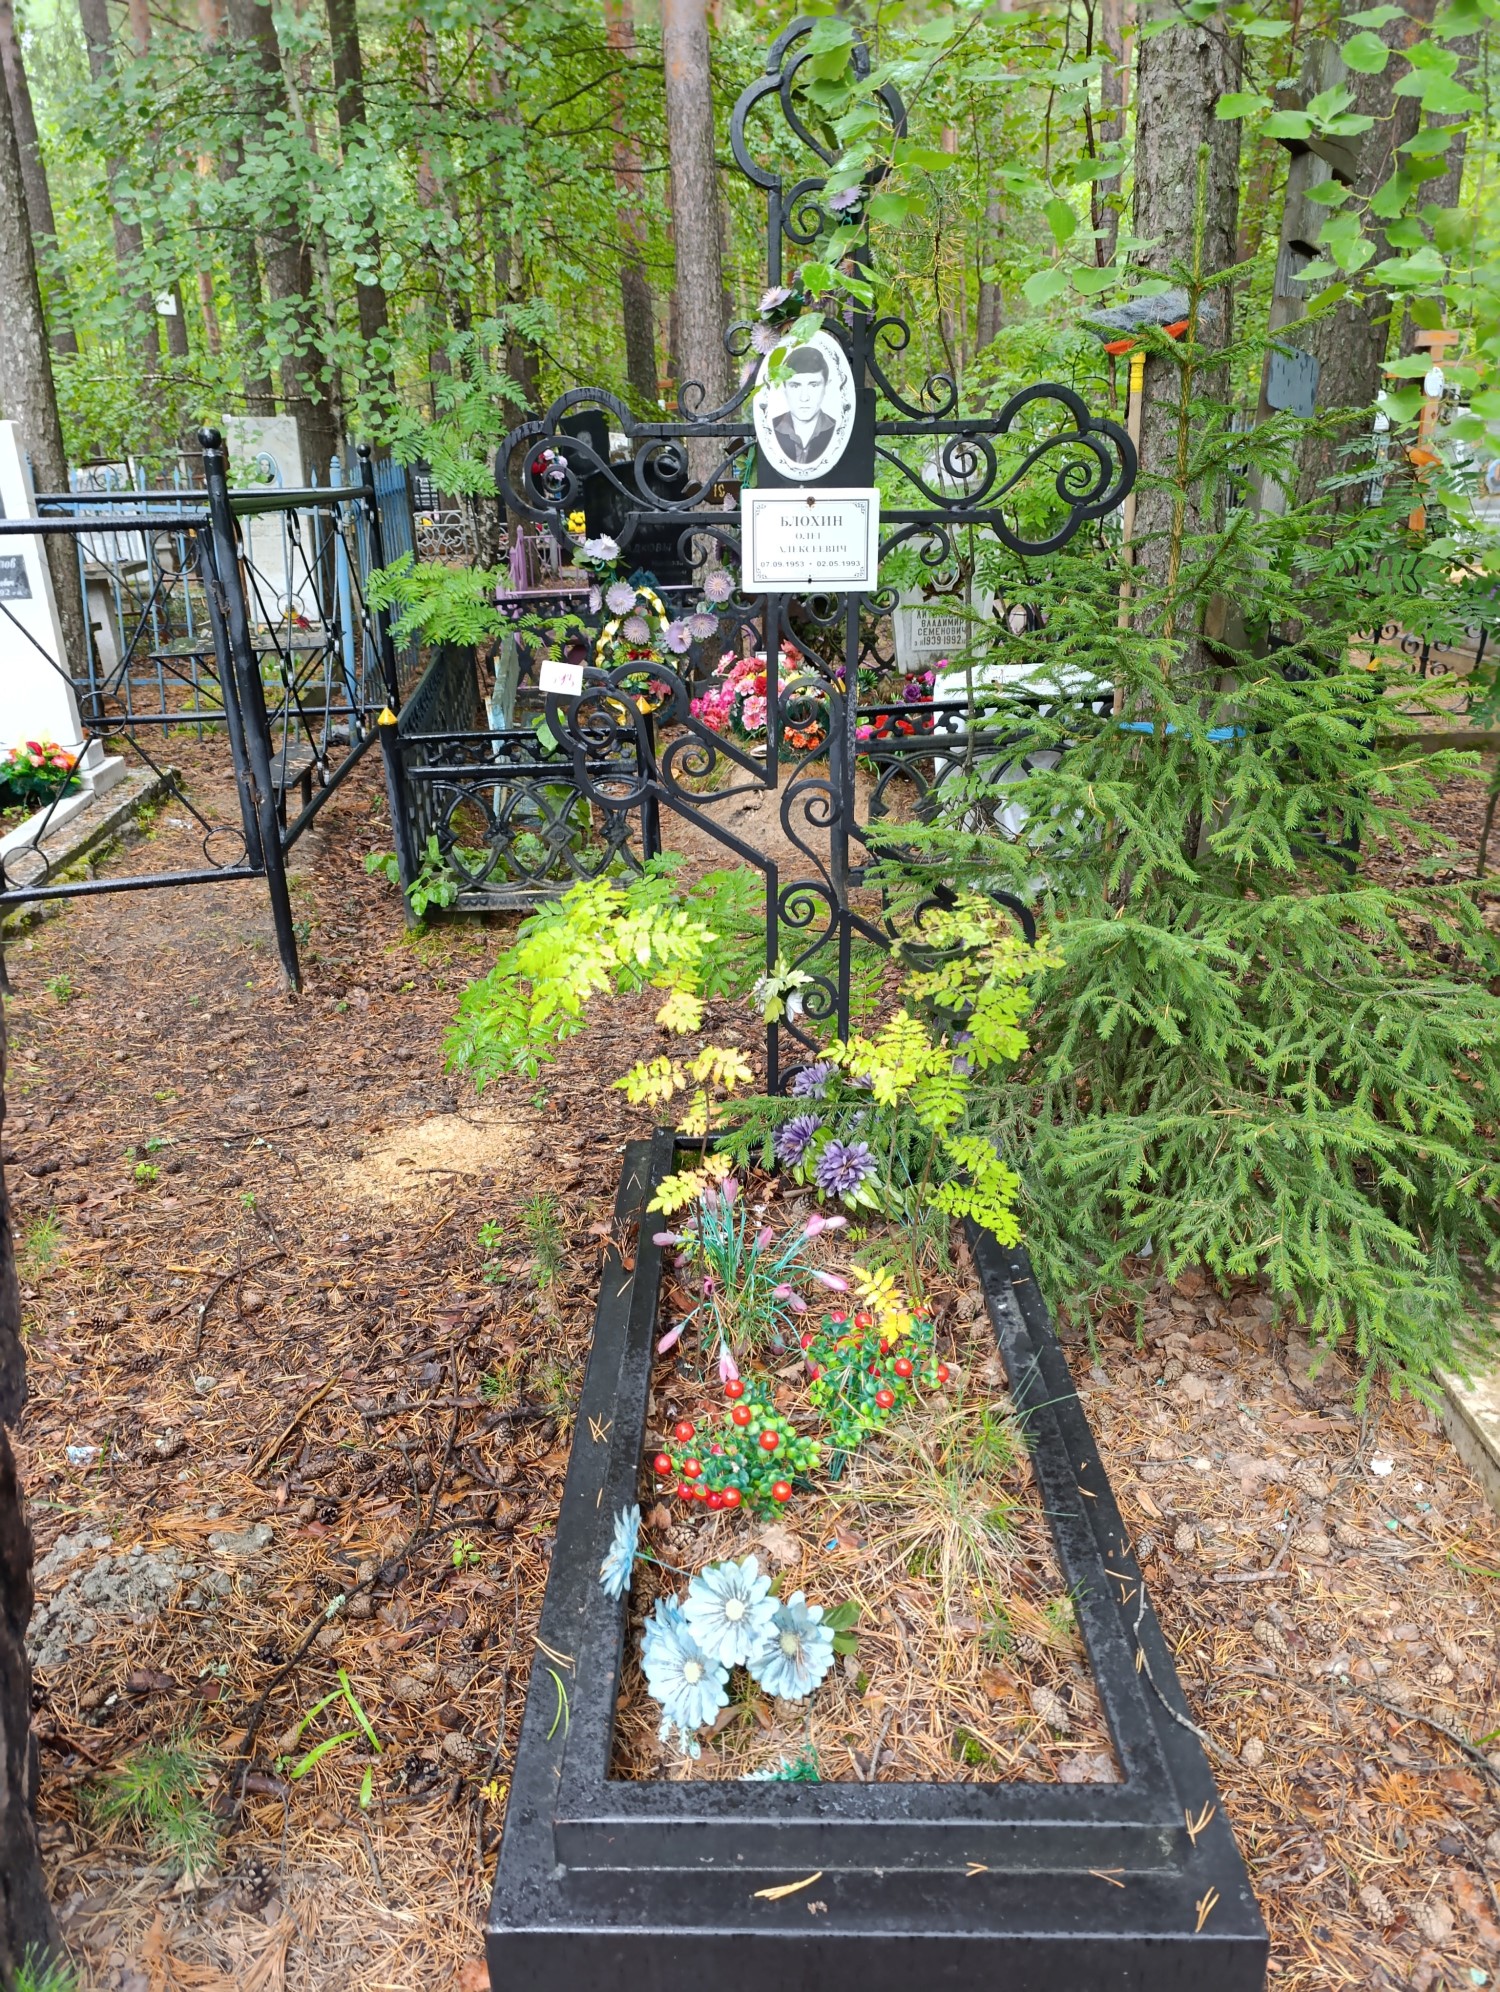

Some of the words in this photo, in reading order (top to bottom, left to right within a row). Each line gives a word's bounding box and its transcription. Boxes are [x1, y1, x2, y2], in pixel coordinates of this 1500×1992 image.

[780, 515, 843, 527] БЛОХИН
[779, 545, 847, 553] АЛЕКСЕЕВИЧ
[921, 618, 965, 628] ВЛАДИМИР
[917, 626, 967, 636] СЕМЕНОВИЧ
